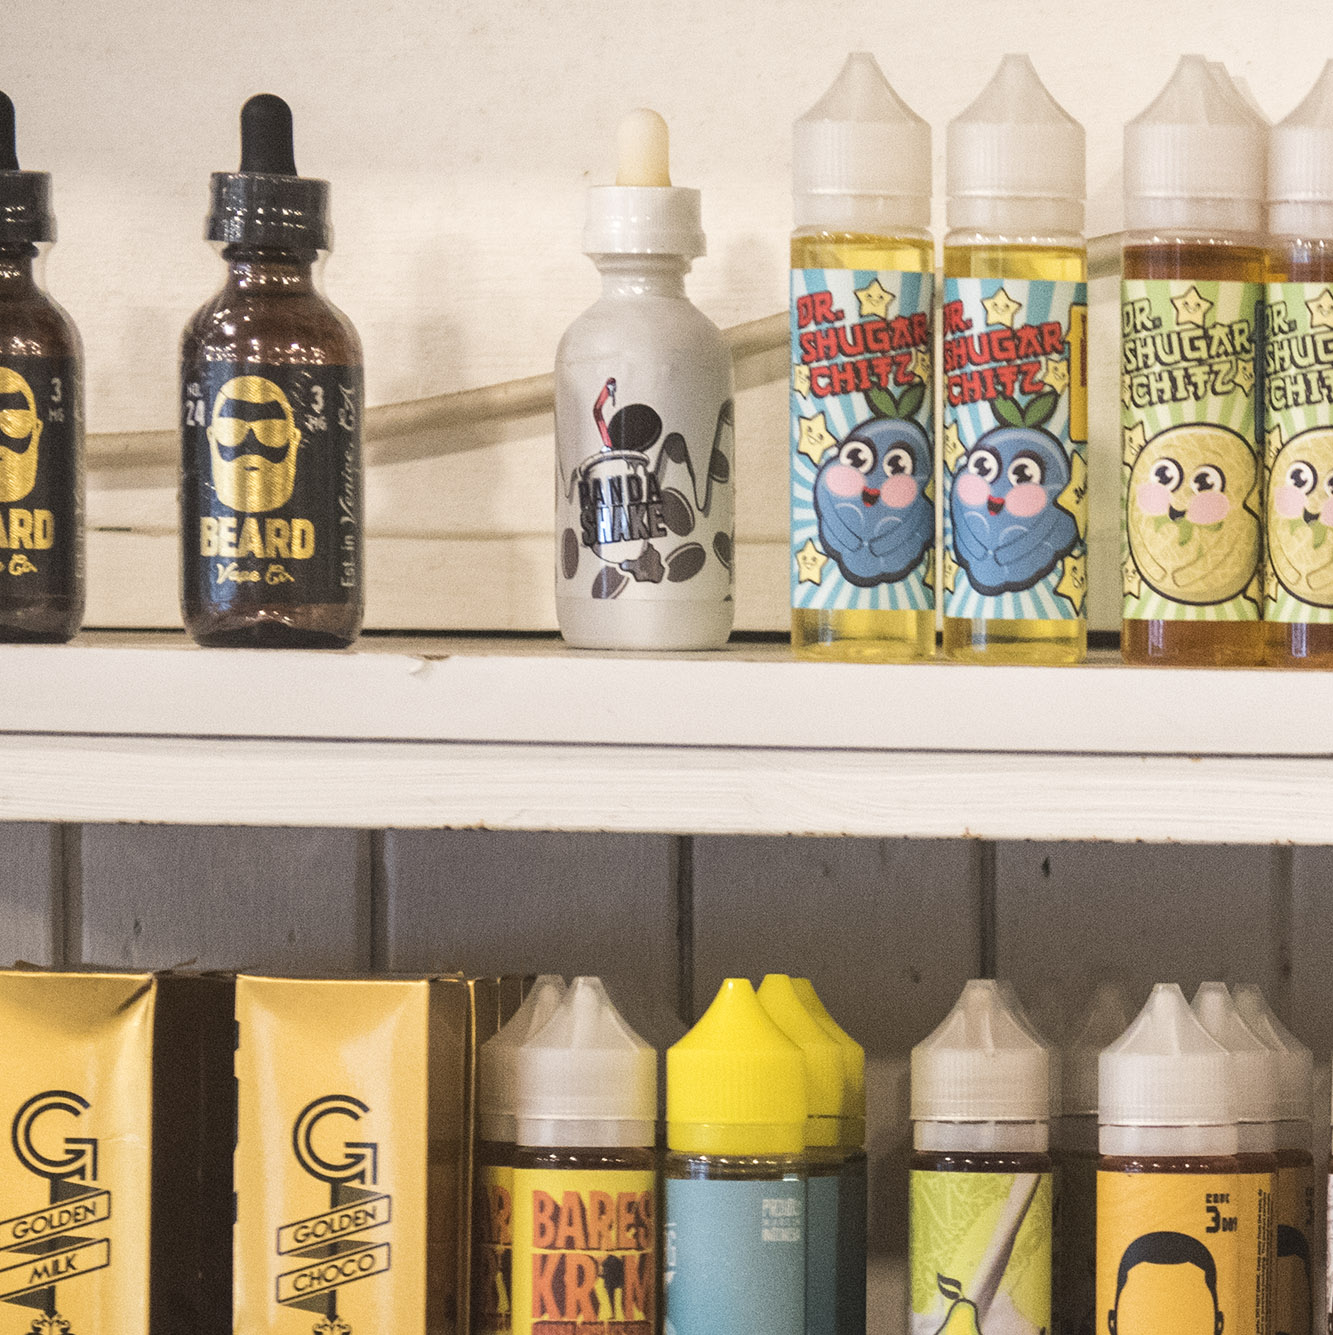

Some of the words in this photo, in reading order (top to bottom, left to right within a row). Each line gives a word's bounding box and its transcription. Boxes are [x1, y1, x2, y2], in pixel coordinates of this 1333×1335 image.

[796, 291, 844, 329] DR.
[1123, 298, 1162, 334] DR.
[800, 312, 931, 365] SHUGAR
[1123, 320, 1255, 373] SHUGAR
[809, 351, 917, 398] CHITZ
[1130, 358, 1238, 408] CHITZ
[578, 470, 663, 509] PANDA
[200, 517, 315, 559] BEARD
[580, 504, 669, 546] SHAKE
[11, 1200, 97, 1241] GOLDEN
[293, 1205, 377, 1245] GOLDEN
[1205, 1205, 1221, 1233] 3
[28, 1255, 80, 1285] MILK
[292, 1253, 377, 1292] CHOCO
